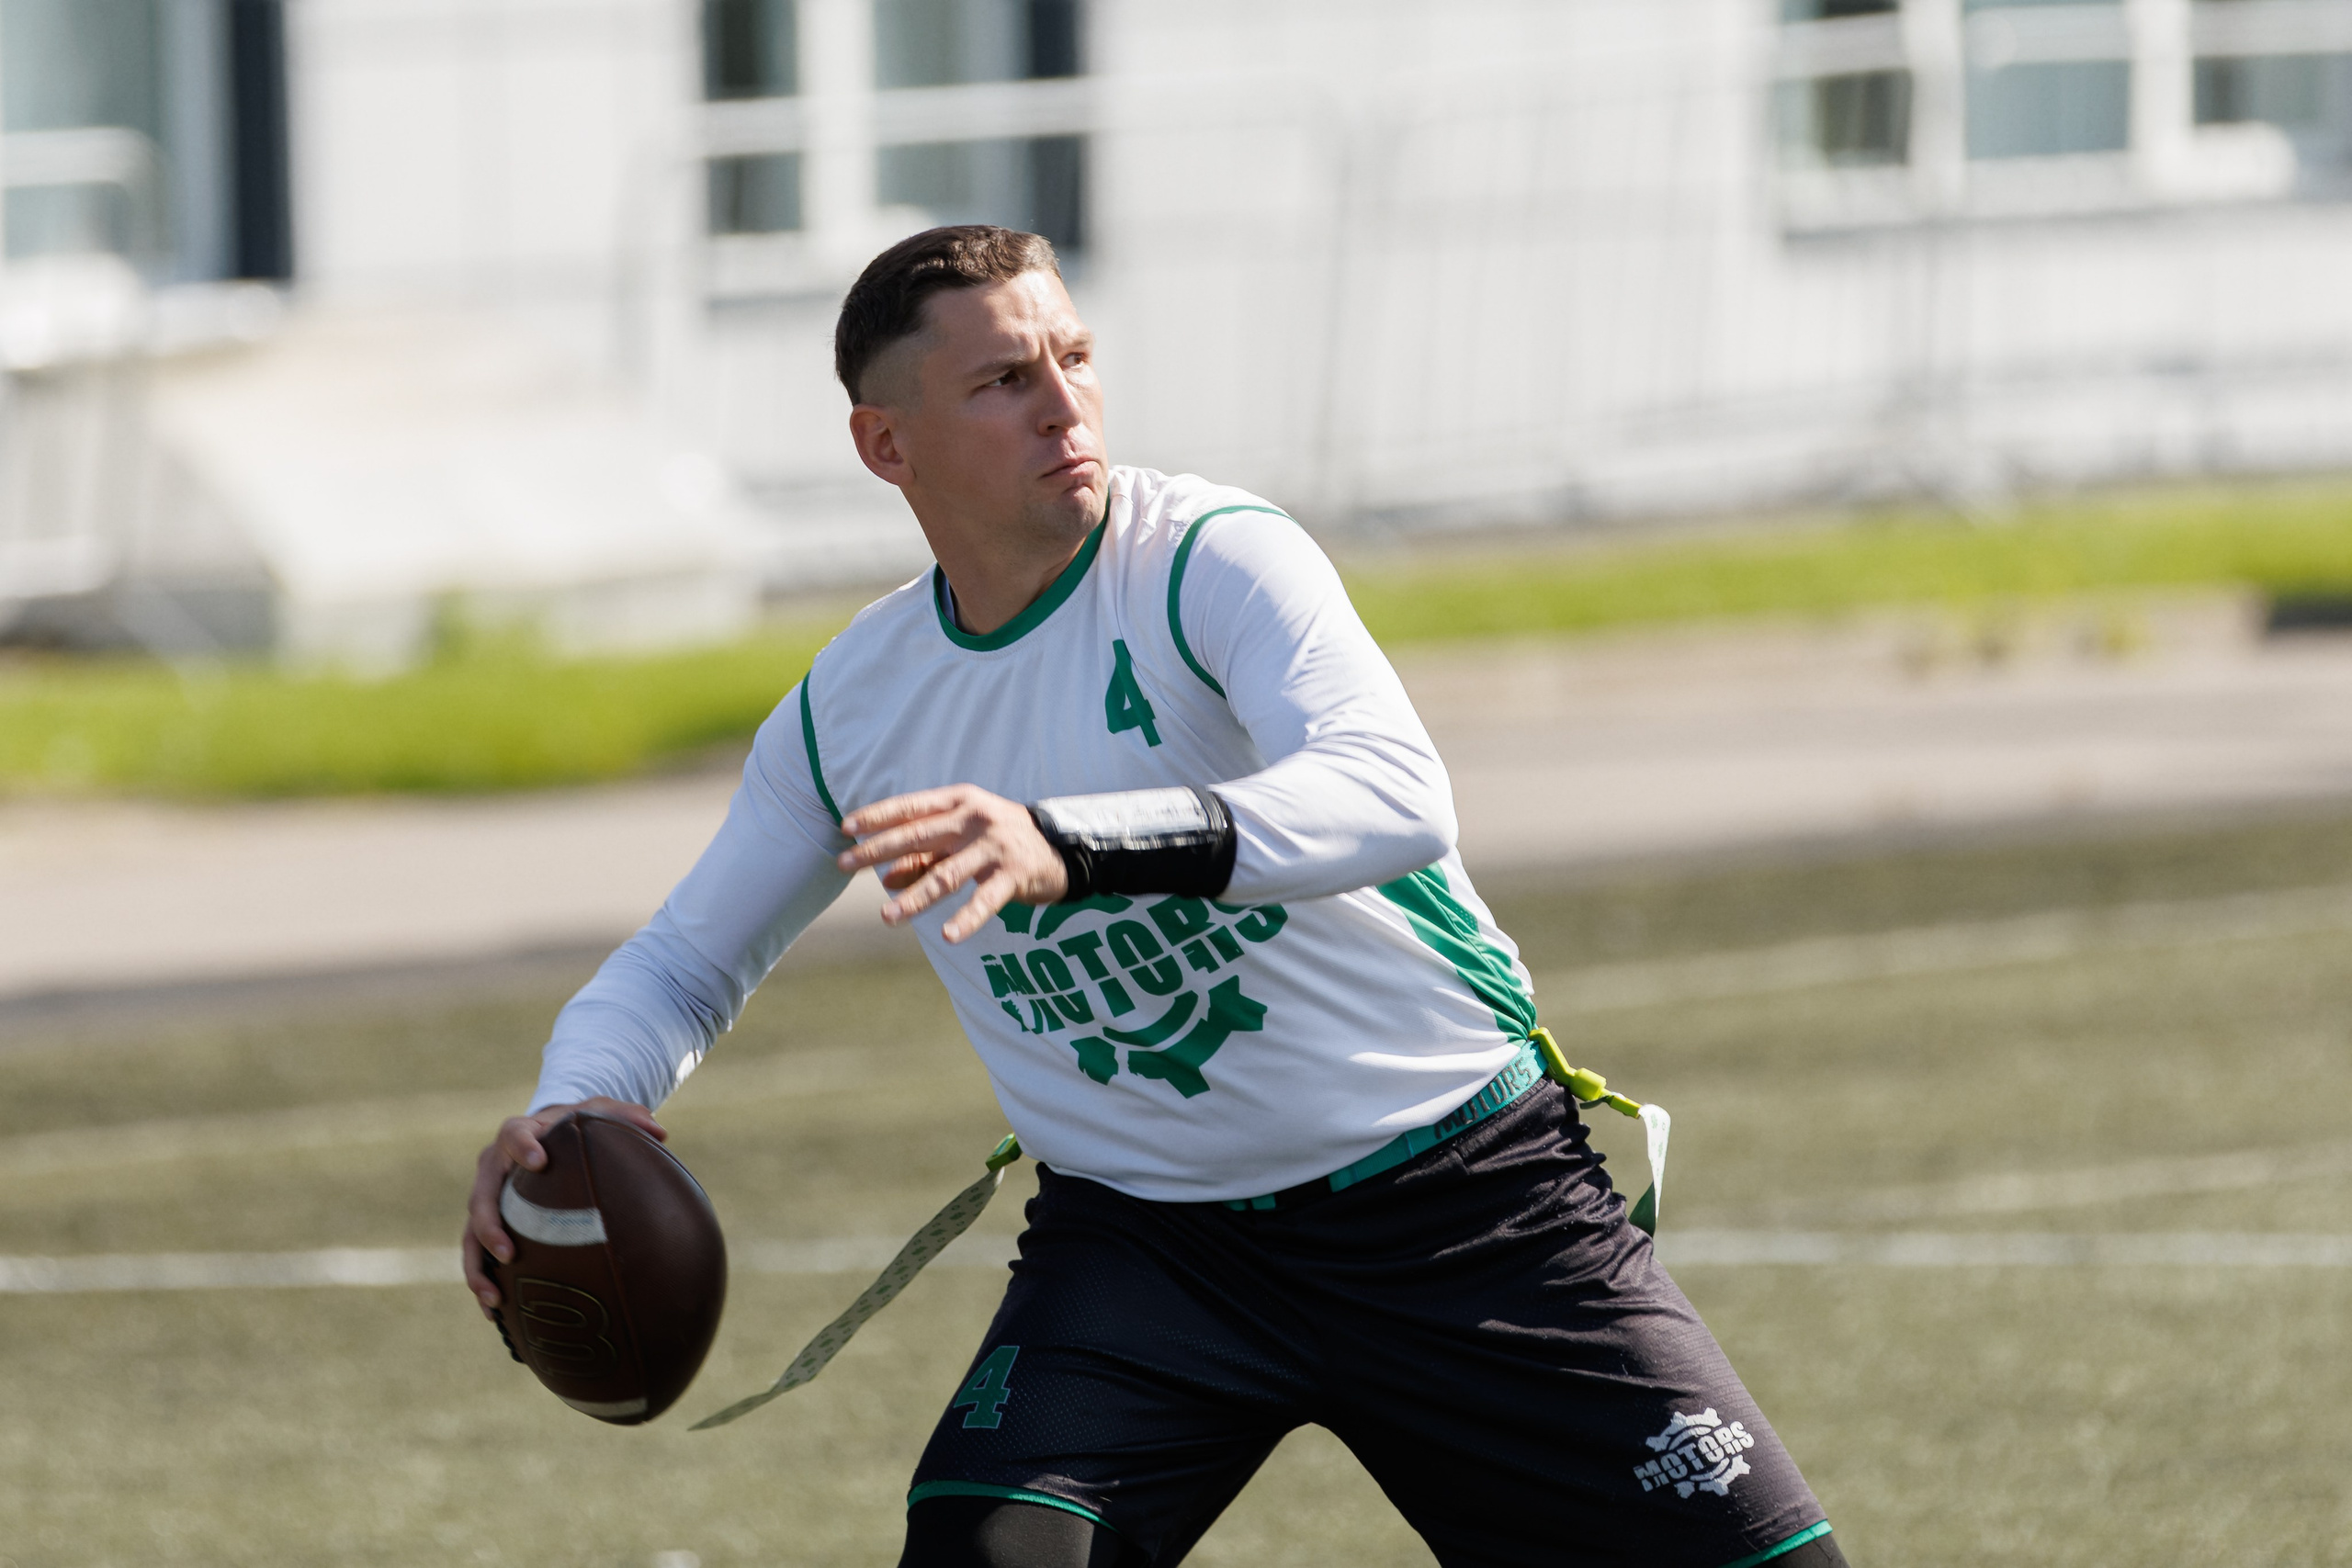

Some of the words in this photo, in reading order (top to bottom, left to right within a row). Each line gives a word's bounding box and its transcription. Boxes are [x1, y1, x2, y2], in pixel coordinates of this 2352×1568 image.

[1105, 638, 1162, 748] 4
[980, 894, 1288, 1034] MOTORS
[954, 1346, 1020, 1428] 4
[1633, 1421, 1755, 1492] MOTORS
